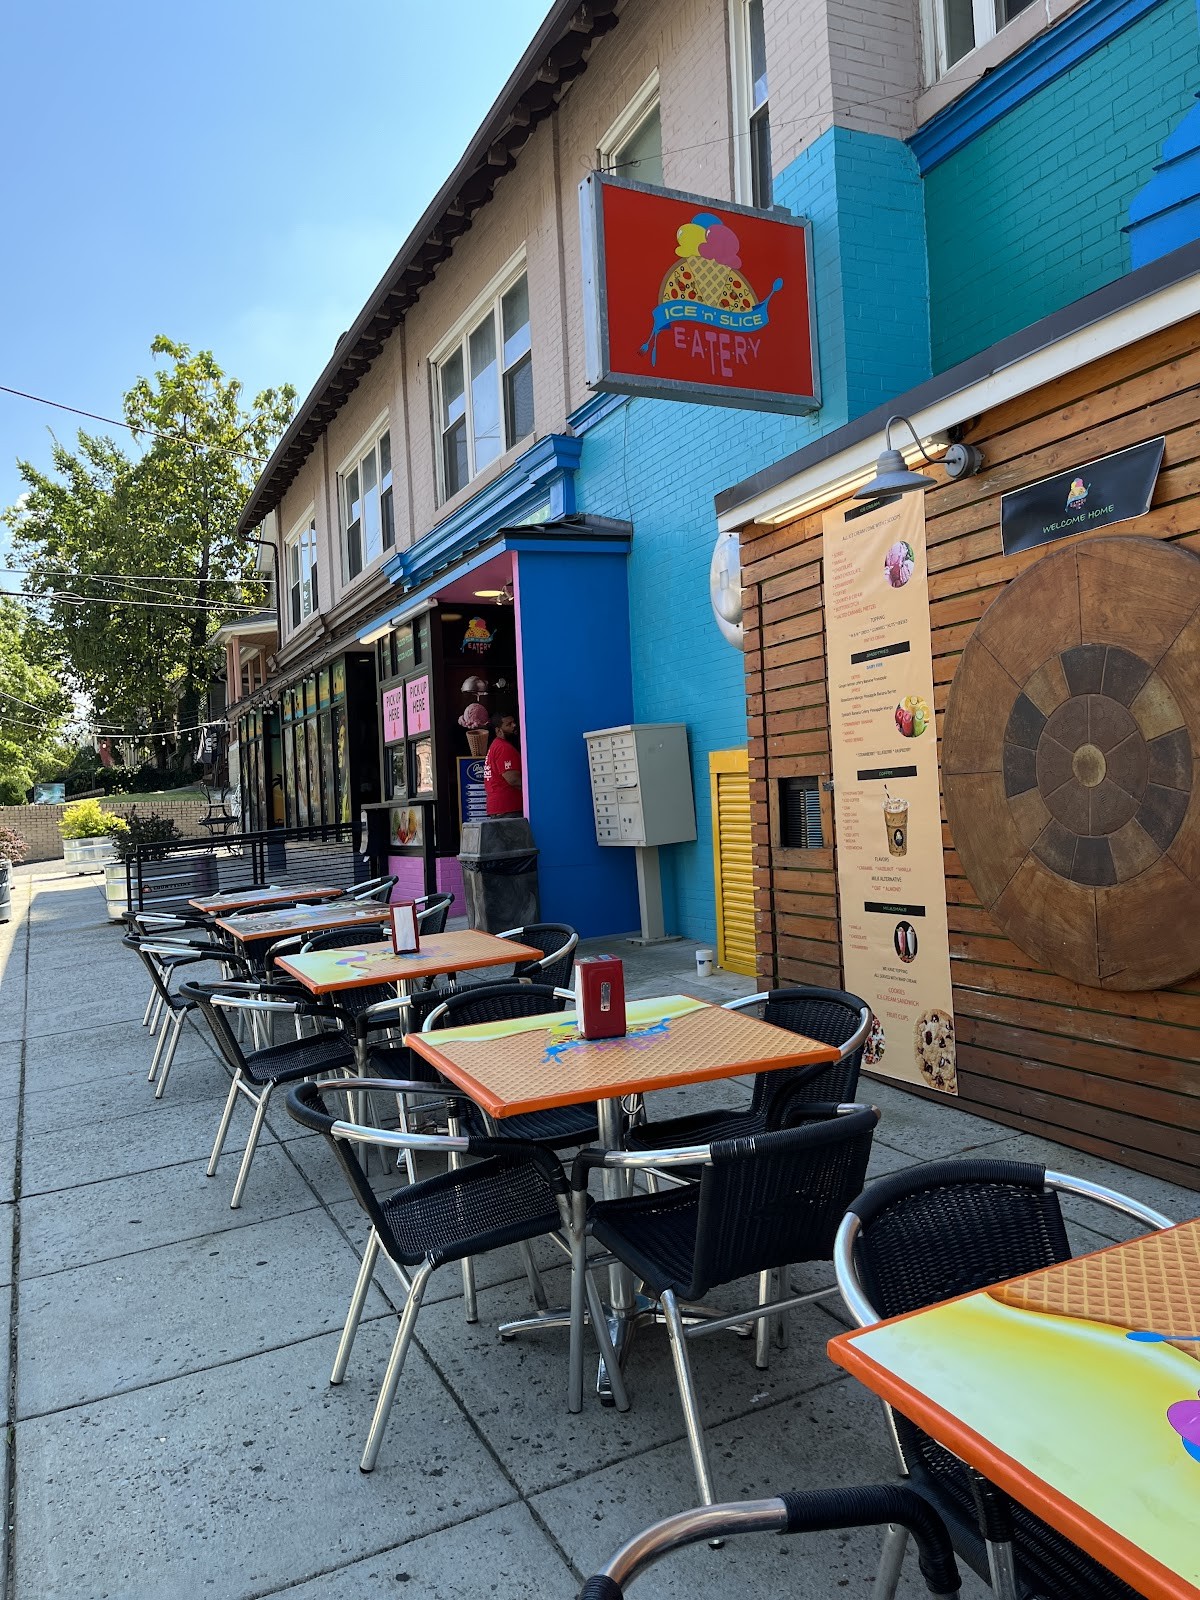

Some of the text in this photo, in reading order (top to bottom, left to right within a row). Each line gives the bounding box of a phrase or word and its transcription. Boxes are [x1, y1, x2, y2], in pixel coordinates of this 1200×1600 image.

[664, 305, 697, 320] ICE
[720, 314, 763, 327] SLICE
[1042, 504, 1114, 533] WELCOME HOME
[410, 681, 427, 698] PICK UP
[386, 692, 401, 707] PICK UP
[412, 698, 425, 714] HERE
[389, 707, 400, 722] HERE
